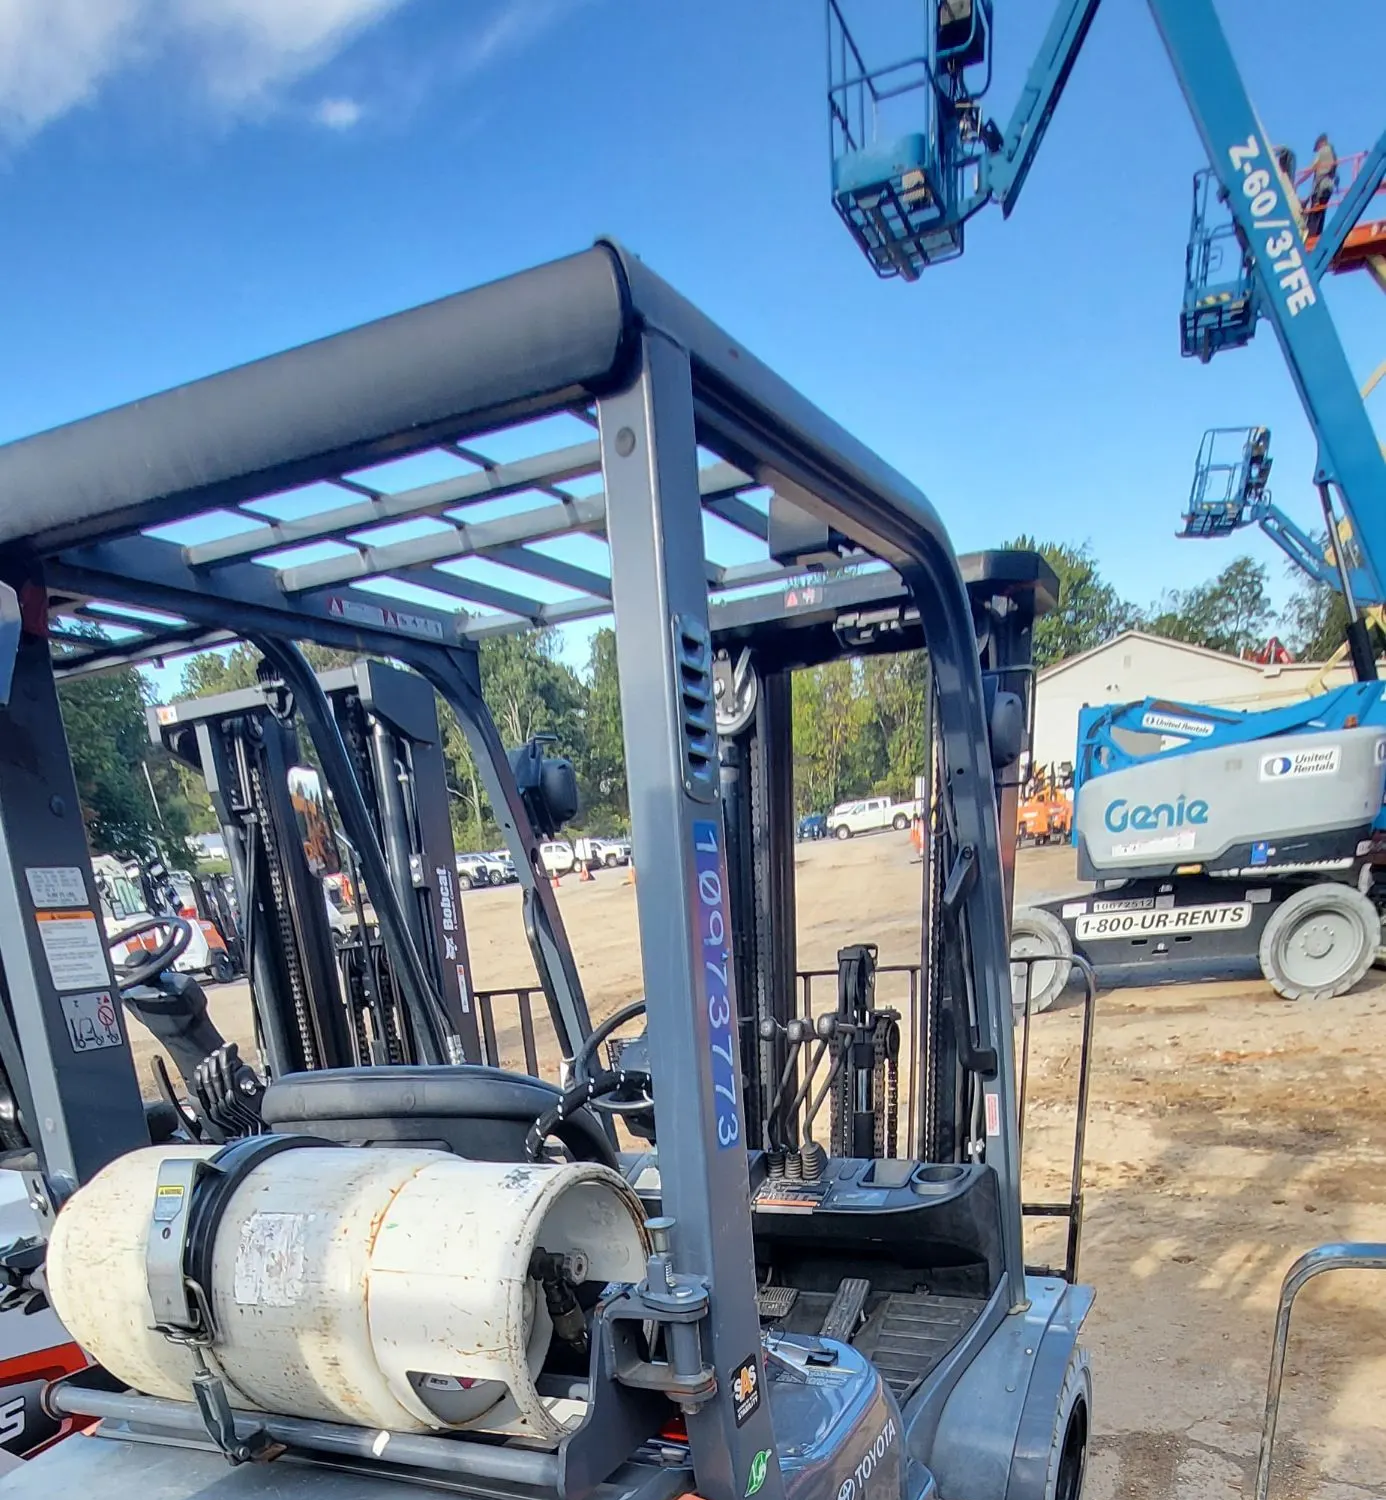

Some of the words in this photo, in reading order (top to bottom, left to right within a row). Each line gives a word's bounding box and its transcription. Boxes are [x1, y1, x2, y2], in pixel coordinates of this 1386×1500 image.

[1229, 134, 1316, 317] Z-60/37FE
[1294, 761, 1335, 774] Rentals
[1295, 751, 1334, 764] United
[1104, 794, 1209, 833] Genie
[435, 864, 454, 931] Bobcat
[1082, 906, 1245, 935] 1-800-UR-RENTS
[695, 830, 739, 1147] 10973773
[854, 1418, 896, 1489] TOYOTA
